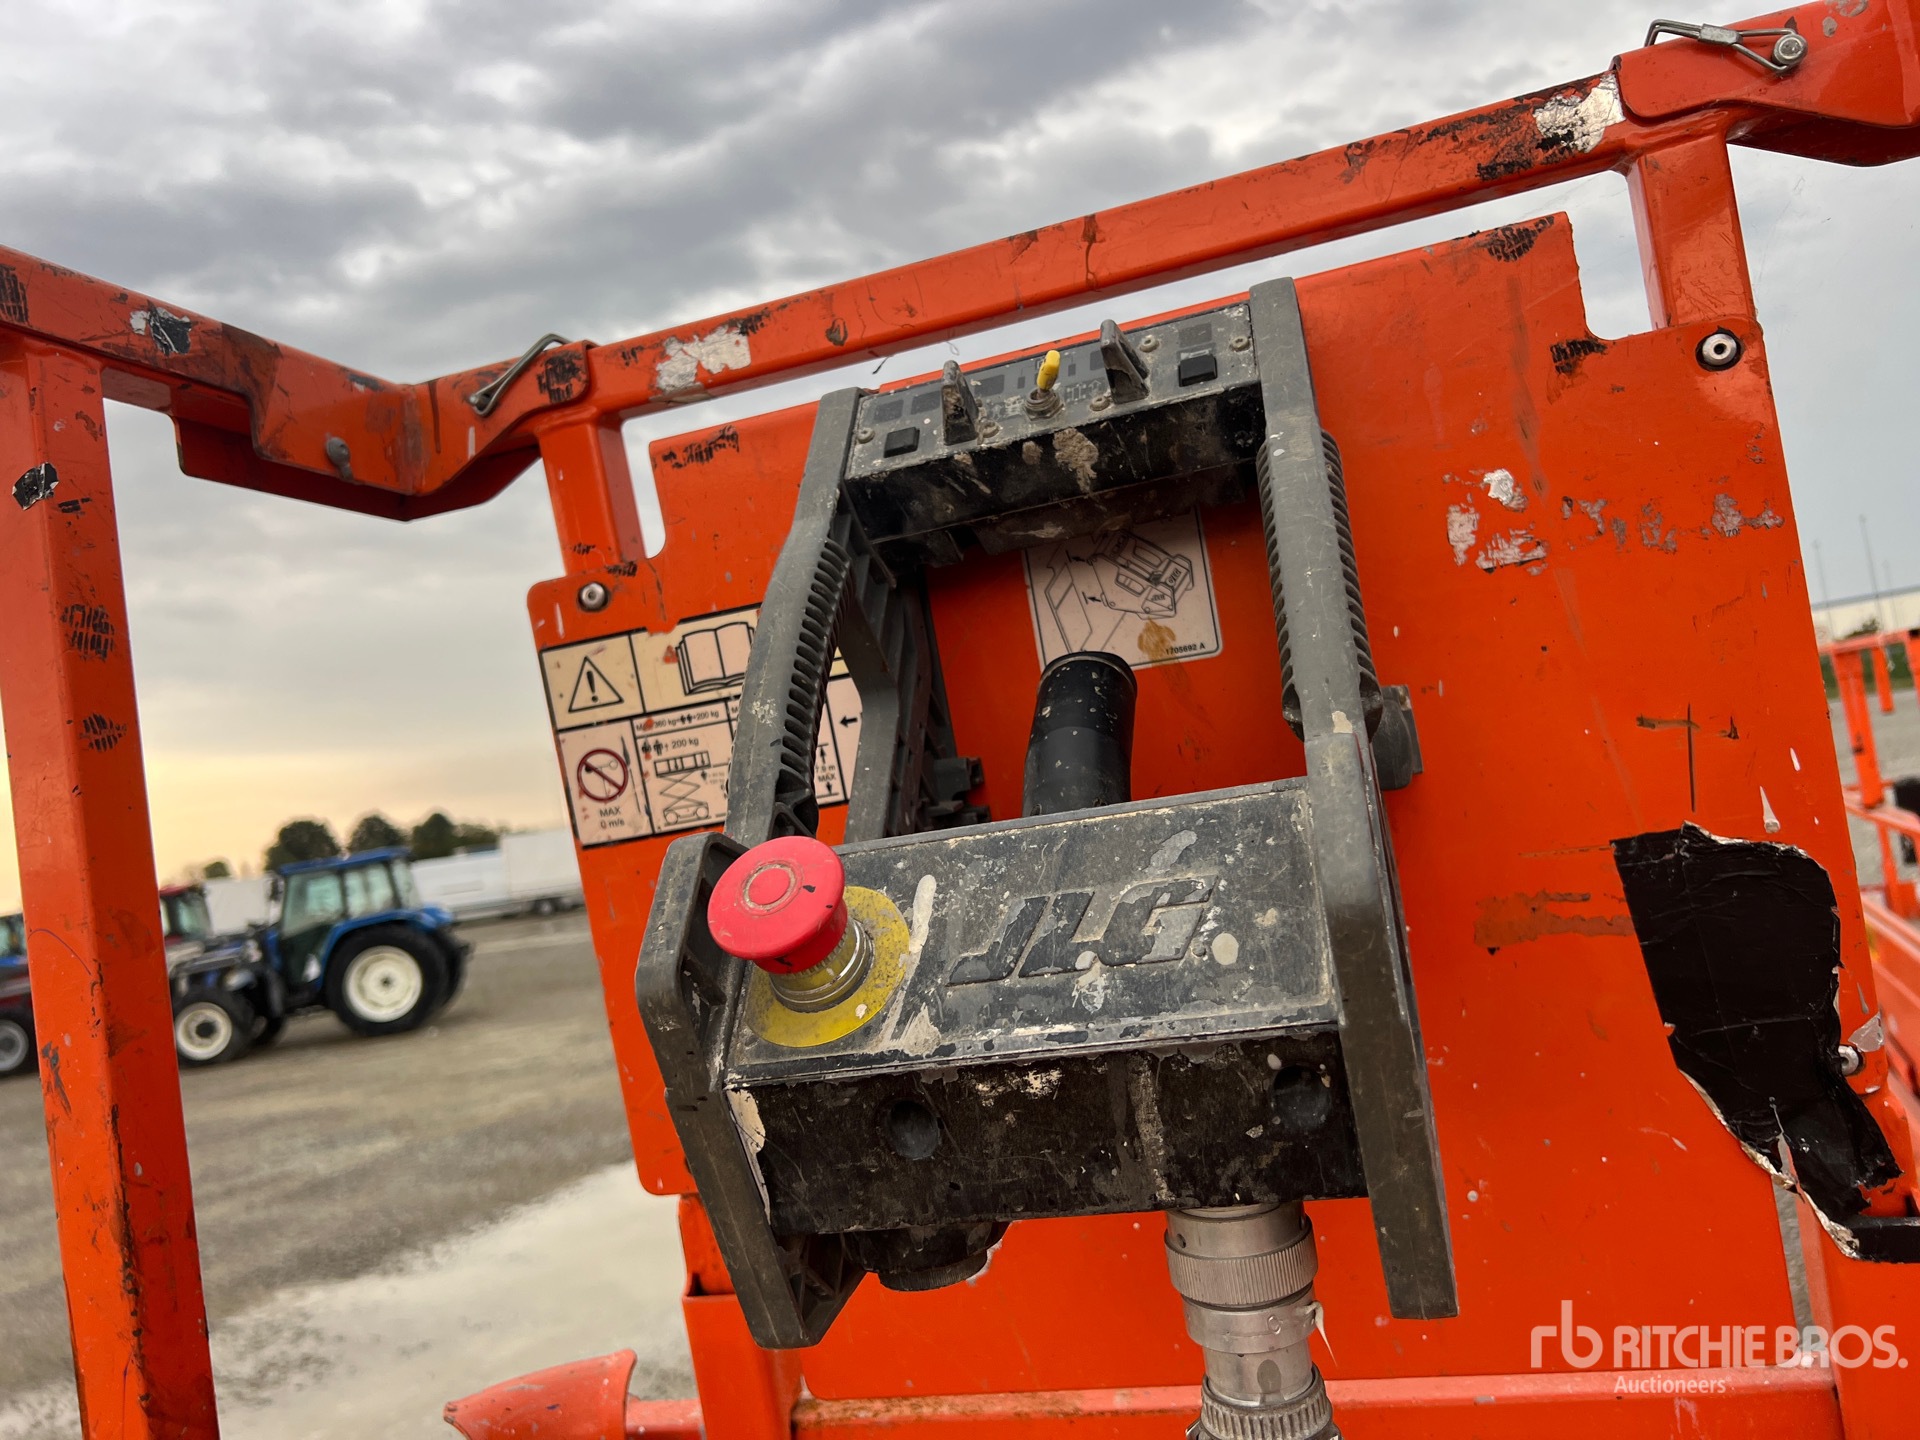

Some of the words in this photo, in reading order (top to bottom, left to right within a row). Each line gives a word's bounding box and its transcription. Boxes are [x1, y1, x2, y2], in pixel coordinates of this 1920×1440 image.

[671, 740, 687, 749] 200
[688, 738, 699, 746] kg
[818, 773, 836, 782] MAX
[599, 806, 621, 817] MAX
[946, 874, 1219, 988] JLG
